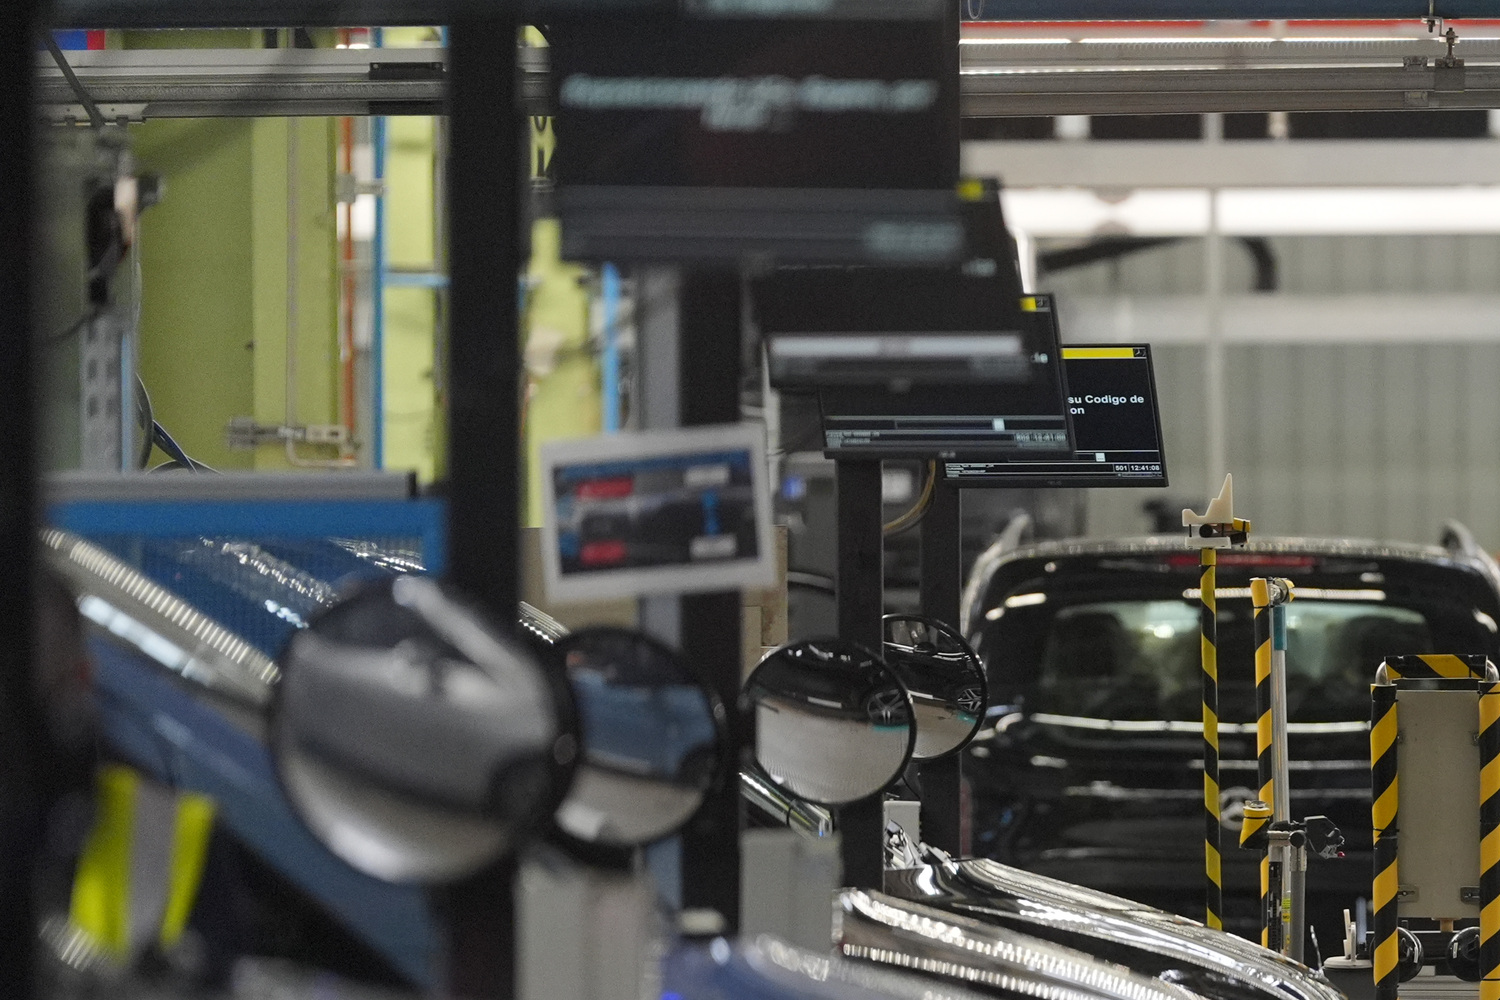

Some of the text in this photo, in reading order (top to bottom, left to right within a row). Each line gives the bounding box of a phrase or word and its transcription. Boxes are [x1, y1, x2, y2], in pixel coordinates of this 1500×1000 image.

[1067, 394, 1145, 406] su Codigo de
